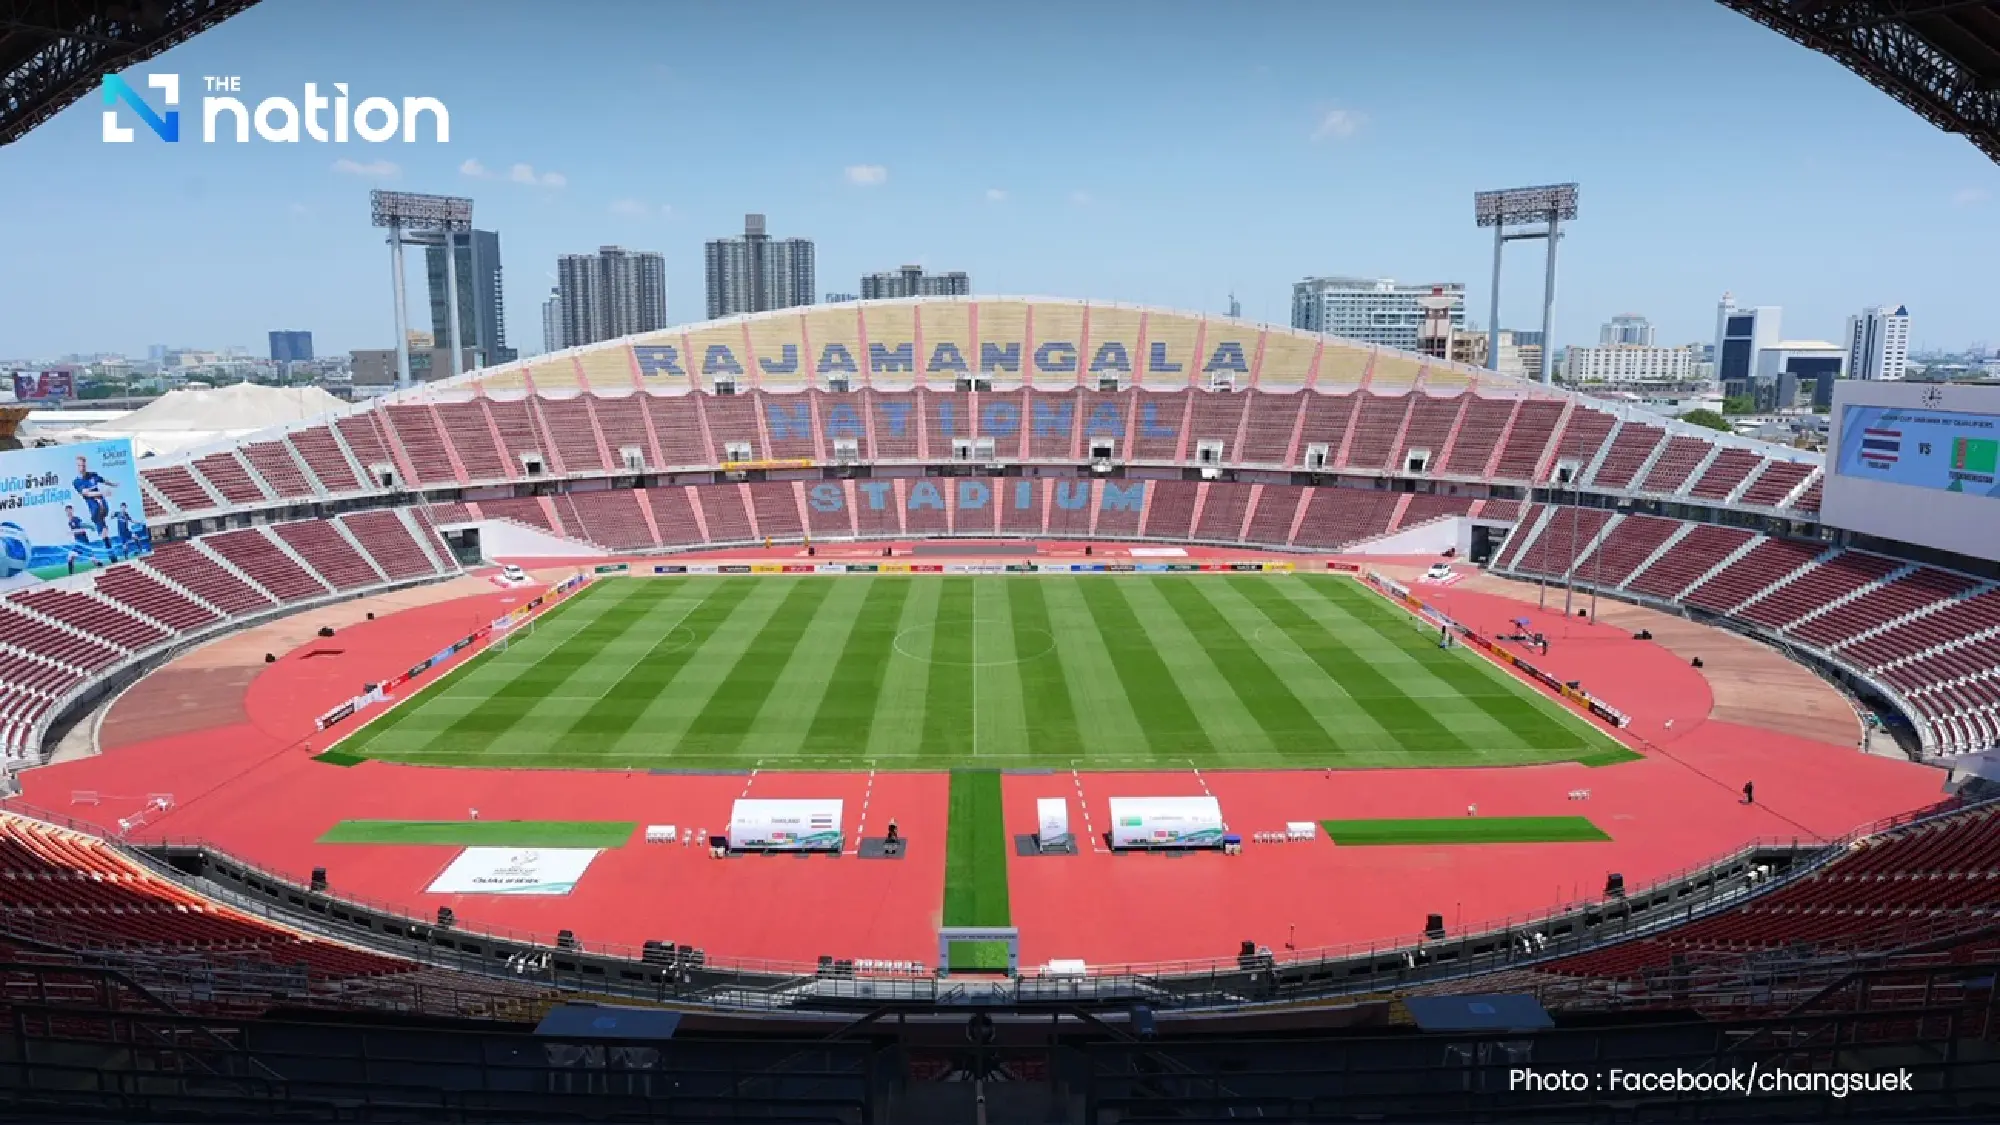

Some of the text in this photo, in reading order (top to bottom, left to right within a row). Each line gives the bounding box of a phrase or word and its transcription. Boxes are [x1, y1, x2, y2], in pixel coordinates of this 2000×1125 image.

[633, 342, 1249, 376] RAJAMANGALA
[766, 400, 1175, 439] NATIONAL
[808, 481, 1147, 512] STADIUM
